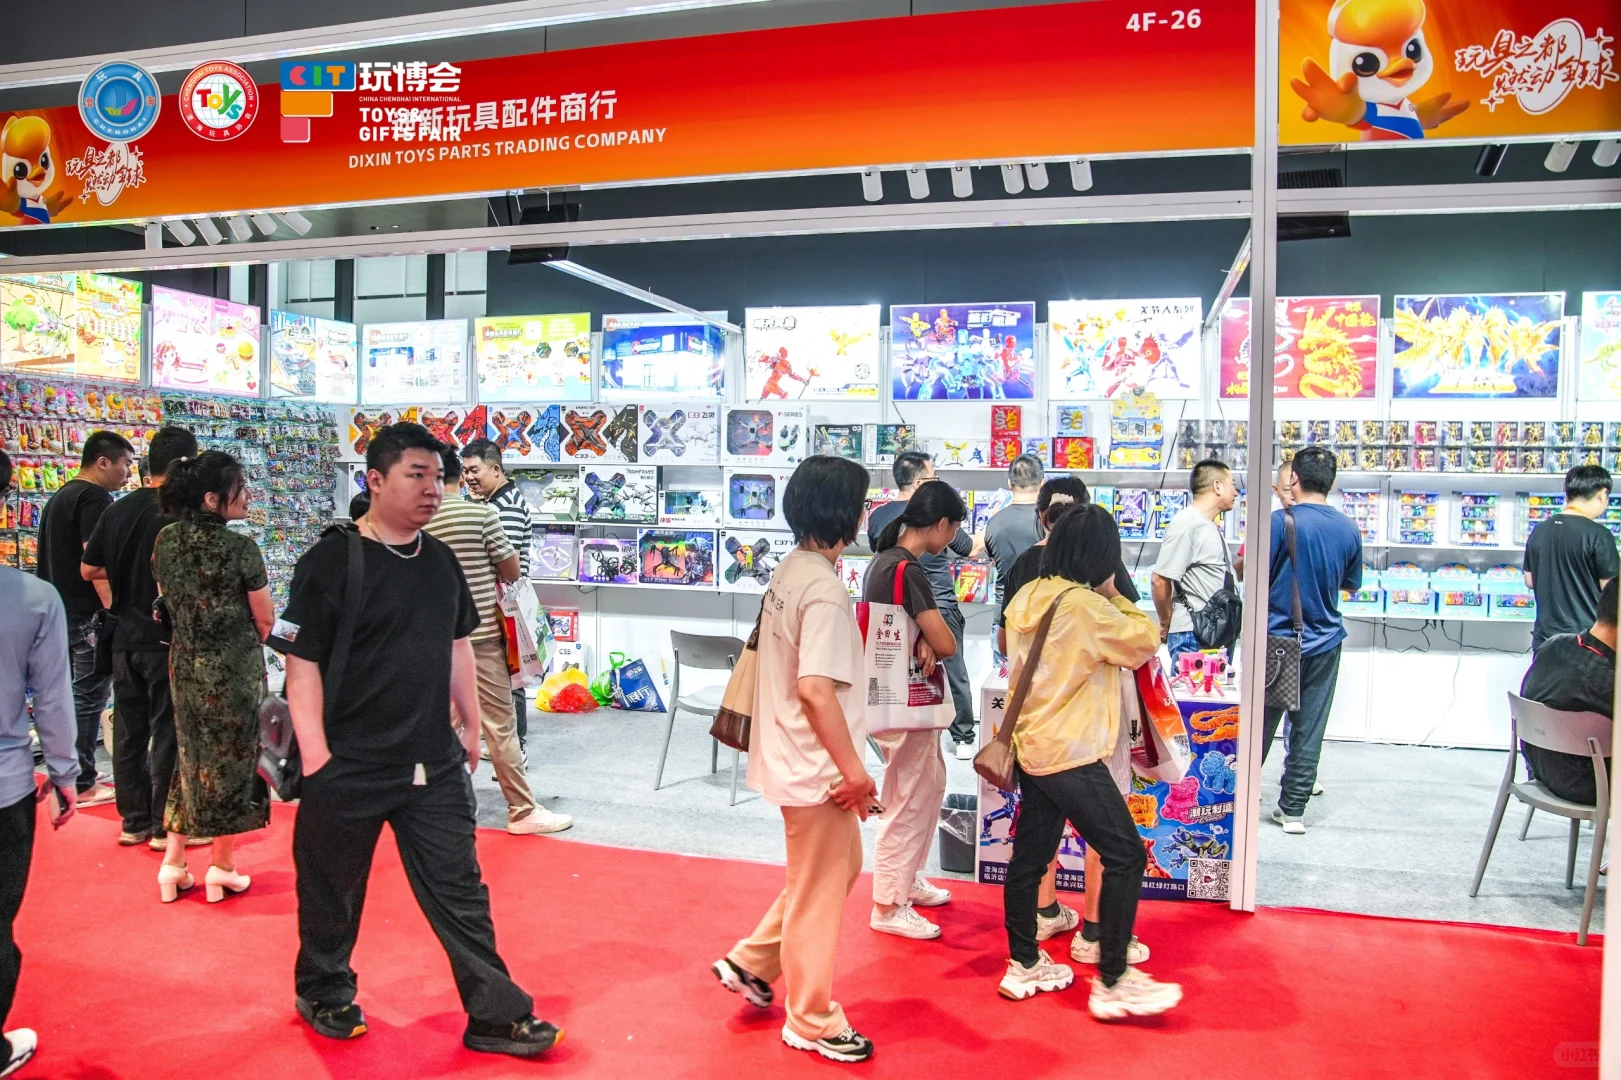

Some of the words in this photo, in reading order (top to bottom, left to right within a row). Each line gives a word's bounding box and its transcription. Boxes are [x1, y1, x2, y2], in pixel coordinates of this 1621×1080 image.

[1125, 9, 1202, 32] 4F-26
[348, 151, 392, 169] DIXIN
[394, 147, 435, 164] TOYS
[438, 141, 491, 161] PARTS
[494, 135, 570, 156] TRADING
[573, 128, 667, 151] COMPANY
